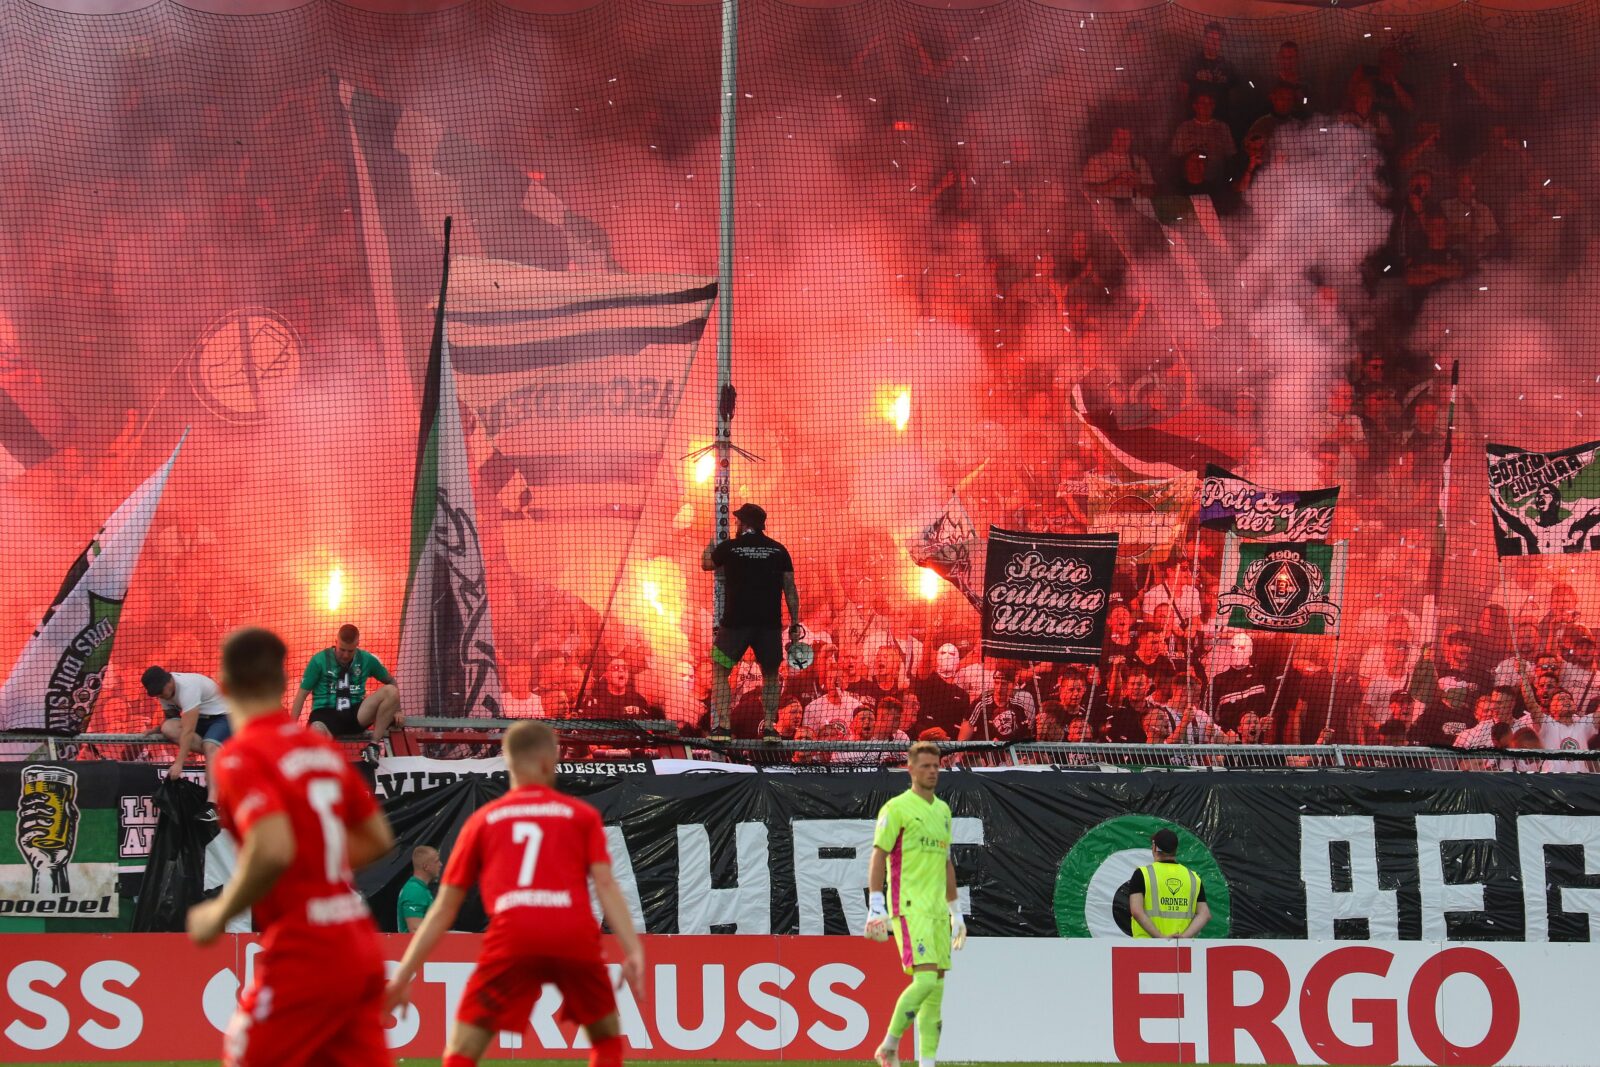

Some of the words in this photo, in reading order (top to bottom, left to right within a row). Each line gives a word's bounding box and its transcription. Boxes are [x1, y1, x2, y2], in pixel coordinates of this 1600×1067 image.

[1236, 508, 1276, 532] der
[1008, 553, 1089, 584] Sotto
[1268, 550, 1300, 561] 1900
[990, 581, 1104, 611] cultura
[996, 605, 1091, 636] Ultras
[512, 822, 544, 887] 7
[1160, 896, 1189, 907] ORDNER
[1111, 945, 1521, 1067] ERGO
